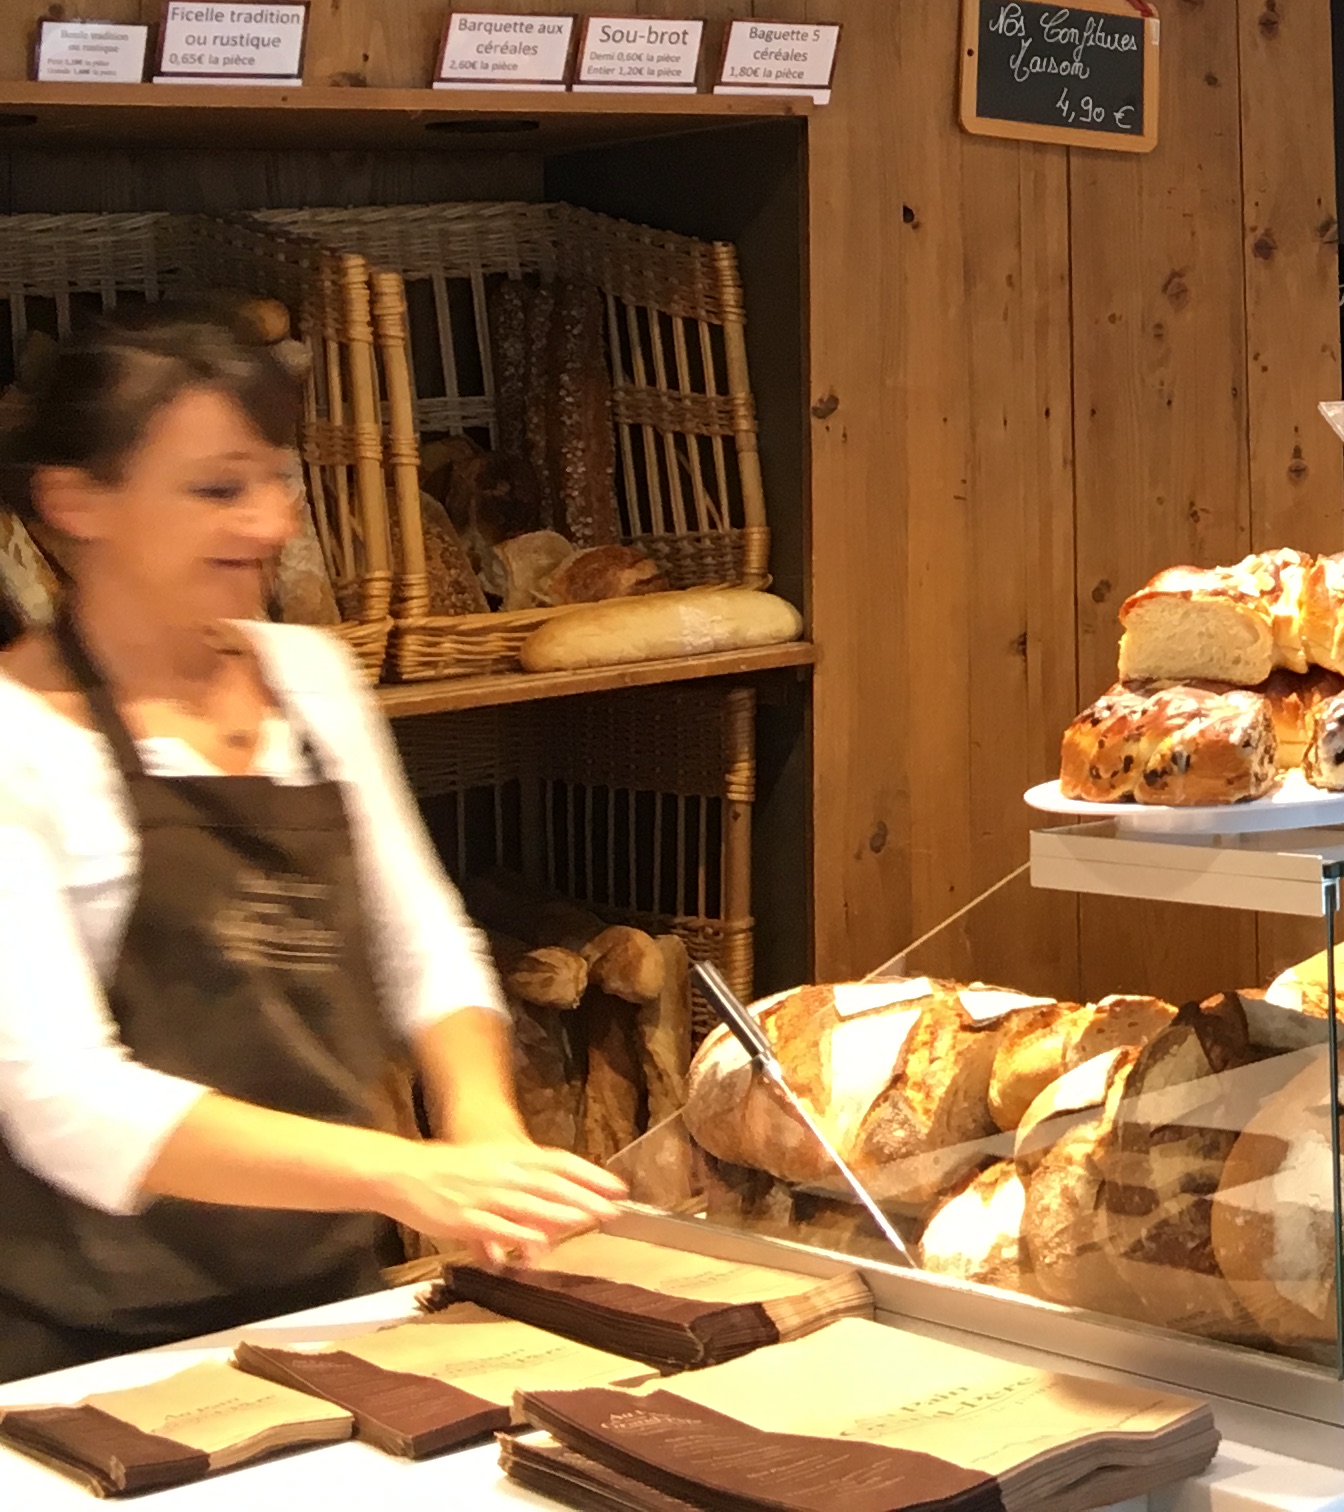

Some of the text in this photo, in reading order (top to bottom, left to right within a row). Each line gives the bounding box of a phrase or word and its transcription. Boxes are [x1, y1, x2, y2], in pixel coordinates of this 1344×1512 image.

[170, 7, 300, 24] Ficelle tradition
[989, 3, 1026, 37] Nos
[458, 18, 564, 35] Barquette aux
[749, 26, 809, 43] Baguette
[185, 33, 282, 50] ou rustique
[599, 25, 689, 45] Sou-brot
[476, 40, 538, 55] céréales
[753, 47, 808, 62] céréales
[208, 53, 219, 65] la
[223, 54, 255, 67] pièce
[589, 51, 614, 61] Demi
[646, 53, 654, 62] la
[656, 53, 681, 63] pièce
[1009, 38, 1090, 82] Maison
[480, 61, 489, 70] la
[491, 61, 518, 72] pièce
[587, 66, 615, 75] Entier
[647, 67, 655, 76] la
[657, 68, 682, 77] pièce
[762, 67, 772, 78] la
[774, 68, 804, 79] pièce
